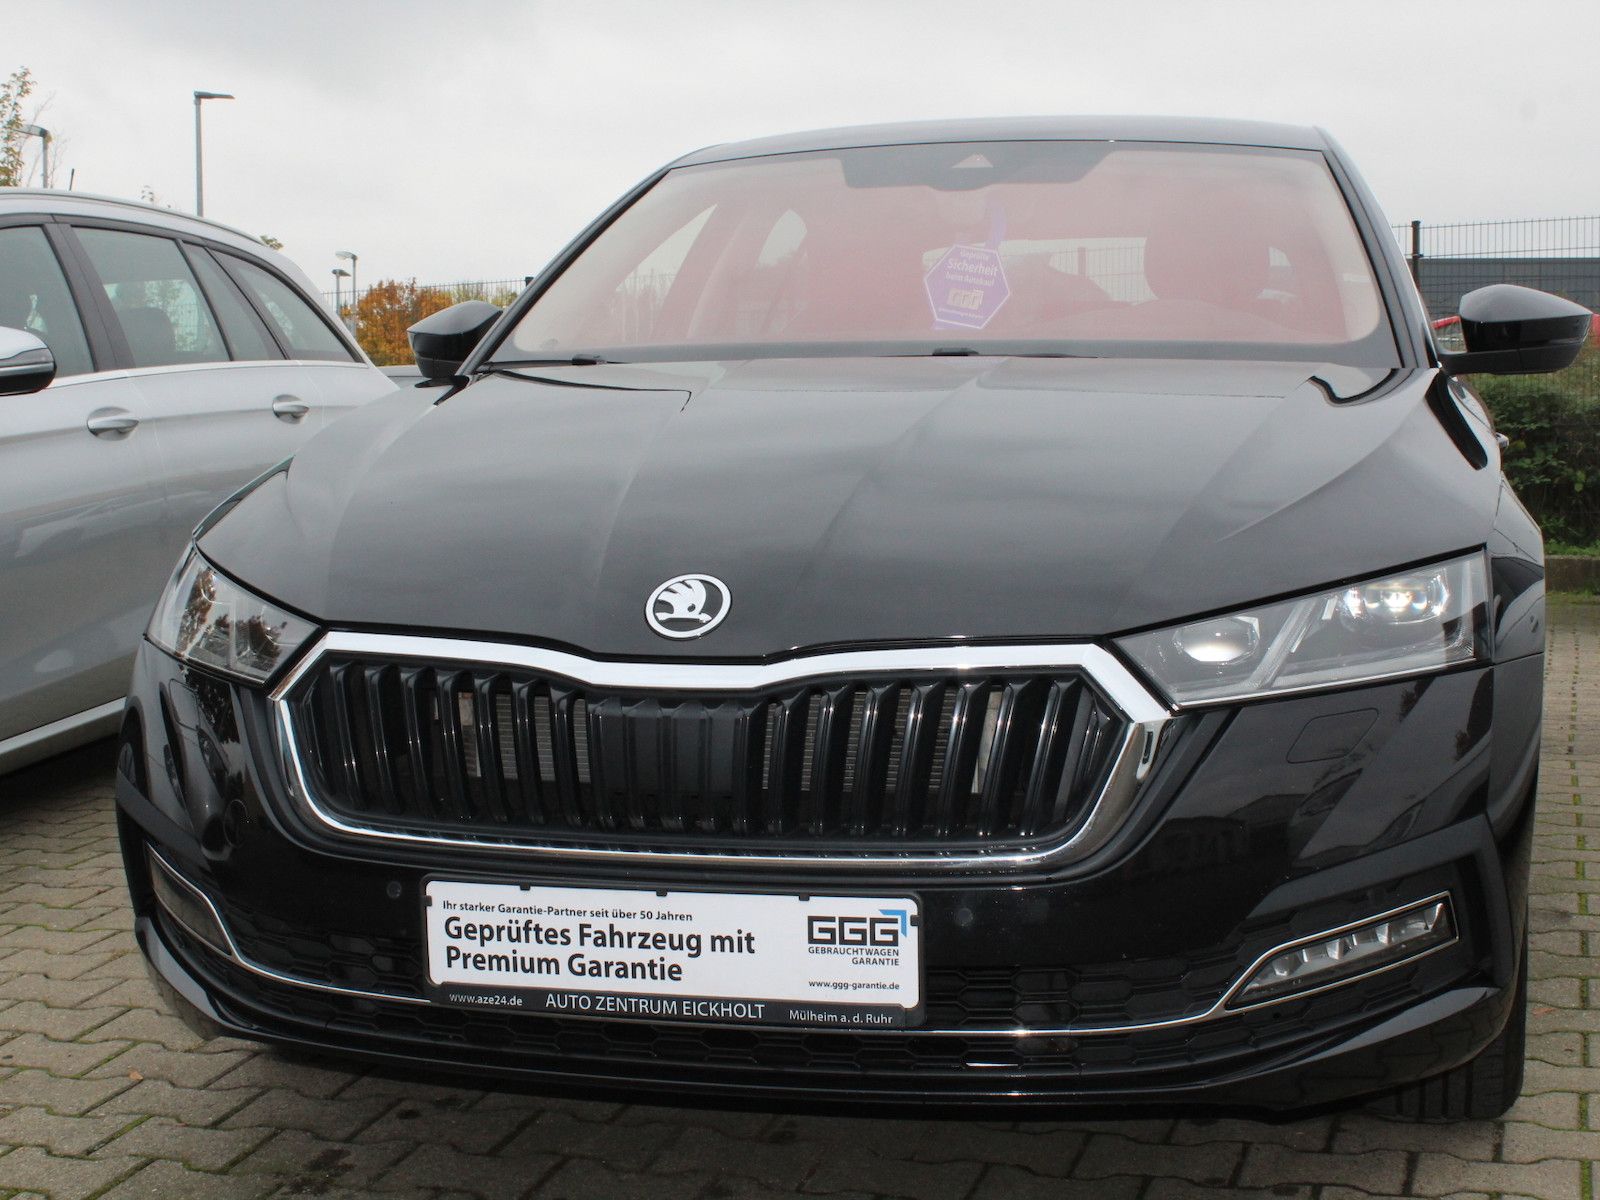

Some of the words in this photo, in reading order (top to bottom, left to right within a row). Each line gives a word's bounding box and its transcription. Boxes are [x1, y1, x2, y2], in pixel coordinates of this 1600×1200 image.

[947, 258, 999, 277] Sicherheit
[443, 900, 457, 910] Ihr
[459, 901, 495, 913] starker
[498, 903, 587, 917] Garantie-Partner
[590, 908, 609, 918] seit
[612, 909, 636, 919] über
[640, 910, 653, 920] 50
[655, 911, 692, 921] Jahren
[444, 916, 571, 947] Geprüftes
[579, 923, 702, 958] Fahrzeug
[710, 929, 755, 954] mit
[807, 915, 899, 946] GGG
[808, 946, 900, 957] GEBRAUCHTWAGEN
[446, 946, 560, 975] Premium
[567, 953, 683, 981] Garantie
[851, 957, 900, 966] GARANTIE
[808, 980, 900, 990] www.ggg-garantie.de
[449, 993, 523, 1006] www.aze24.de
[545, 993, 591, 1010] AUTO
[595, 995, 678, 1015] ZENTRUM
[682, 1001, 765, 1019] EICKHOLT
[789, 1009, 839, 1022] Mülheim
[840, 1013, 851, 1023] a.
[853, 1013, 864, 1023] d.
[866, 1013, 893, 1024] Ruhr
